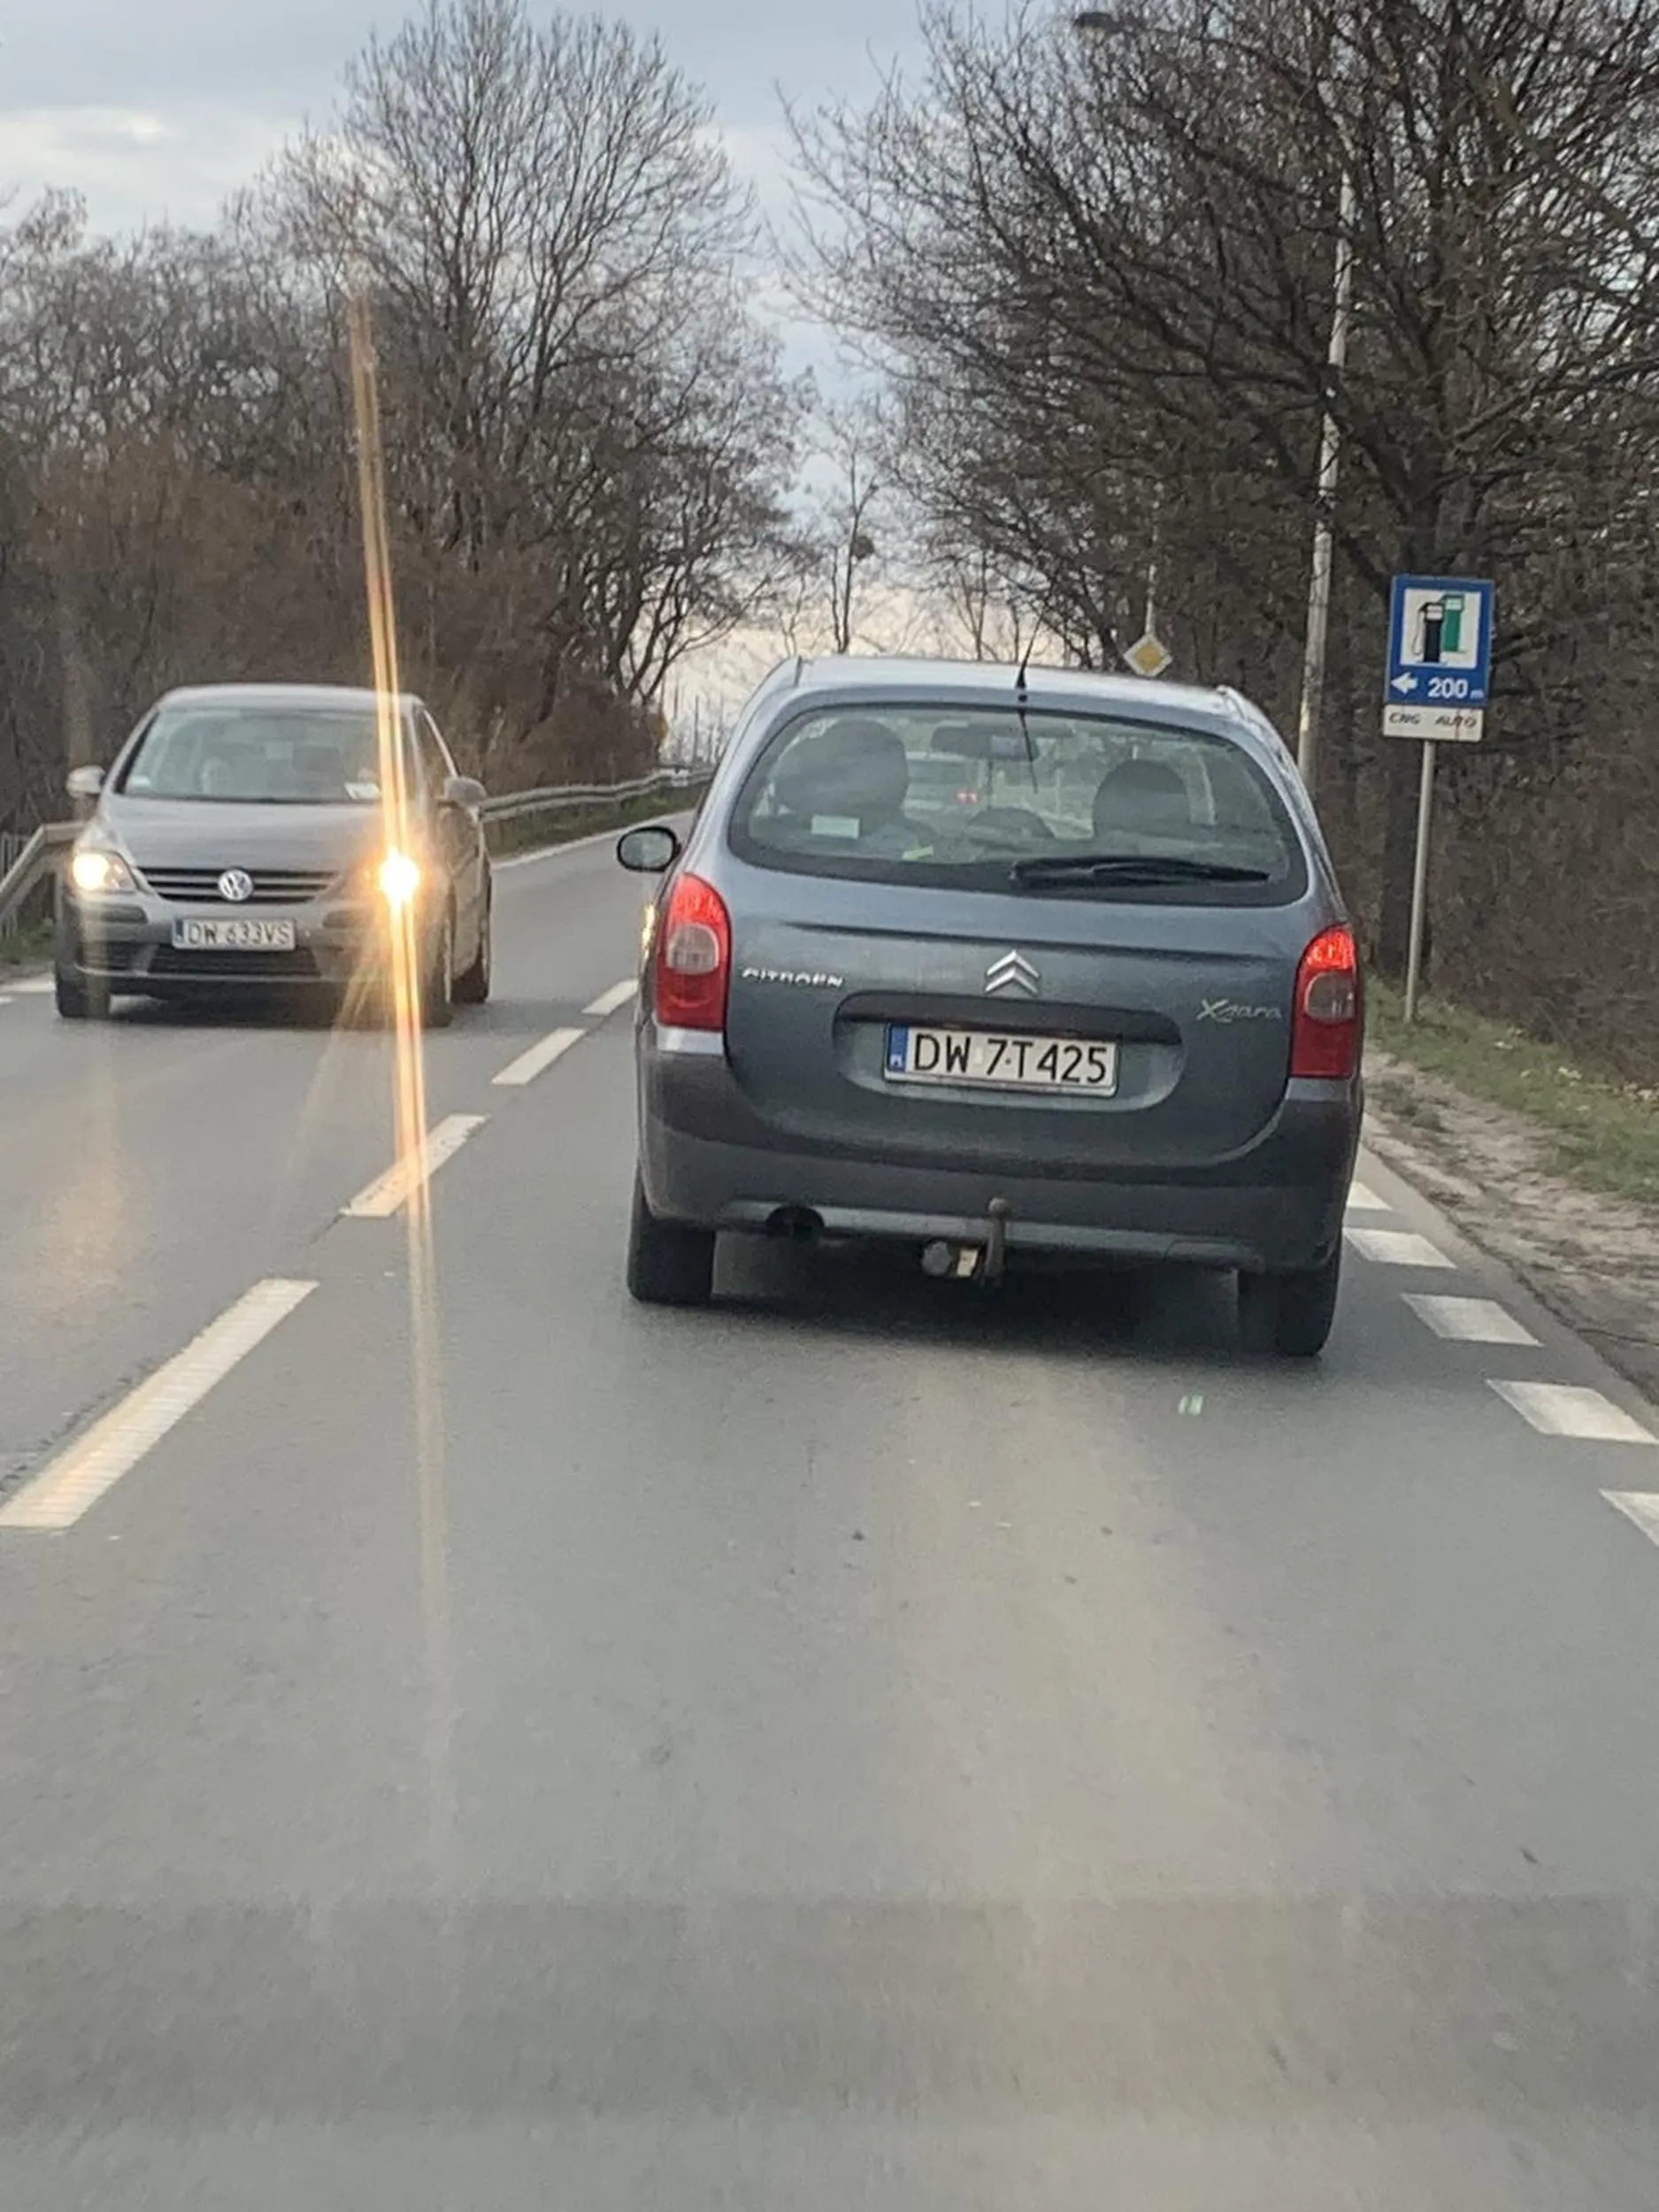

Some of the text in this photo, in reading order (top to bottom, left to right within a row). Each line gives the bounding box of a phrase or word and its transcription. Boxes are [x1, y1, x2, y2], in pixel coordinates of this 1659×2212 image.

[1427, 676, 1469, 699] 200
[1435, 714, 1477, 728] AUTO
[188, 922, 216, 944] DW
[915, 1033, 1108, 1084] DW 7T425
